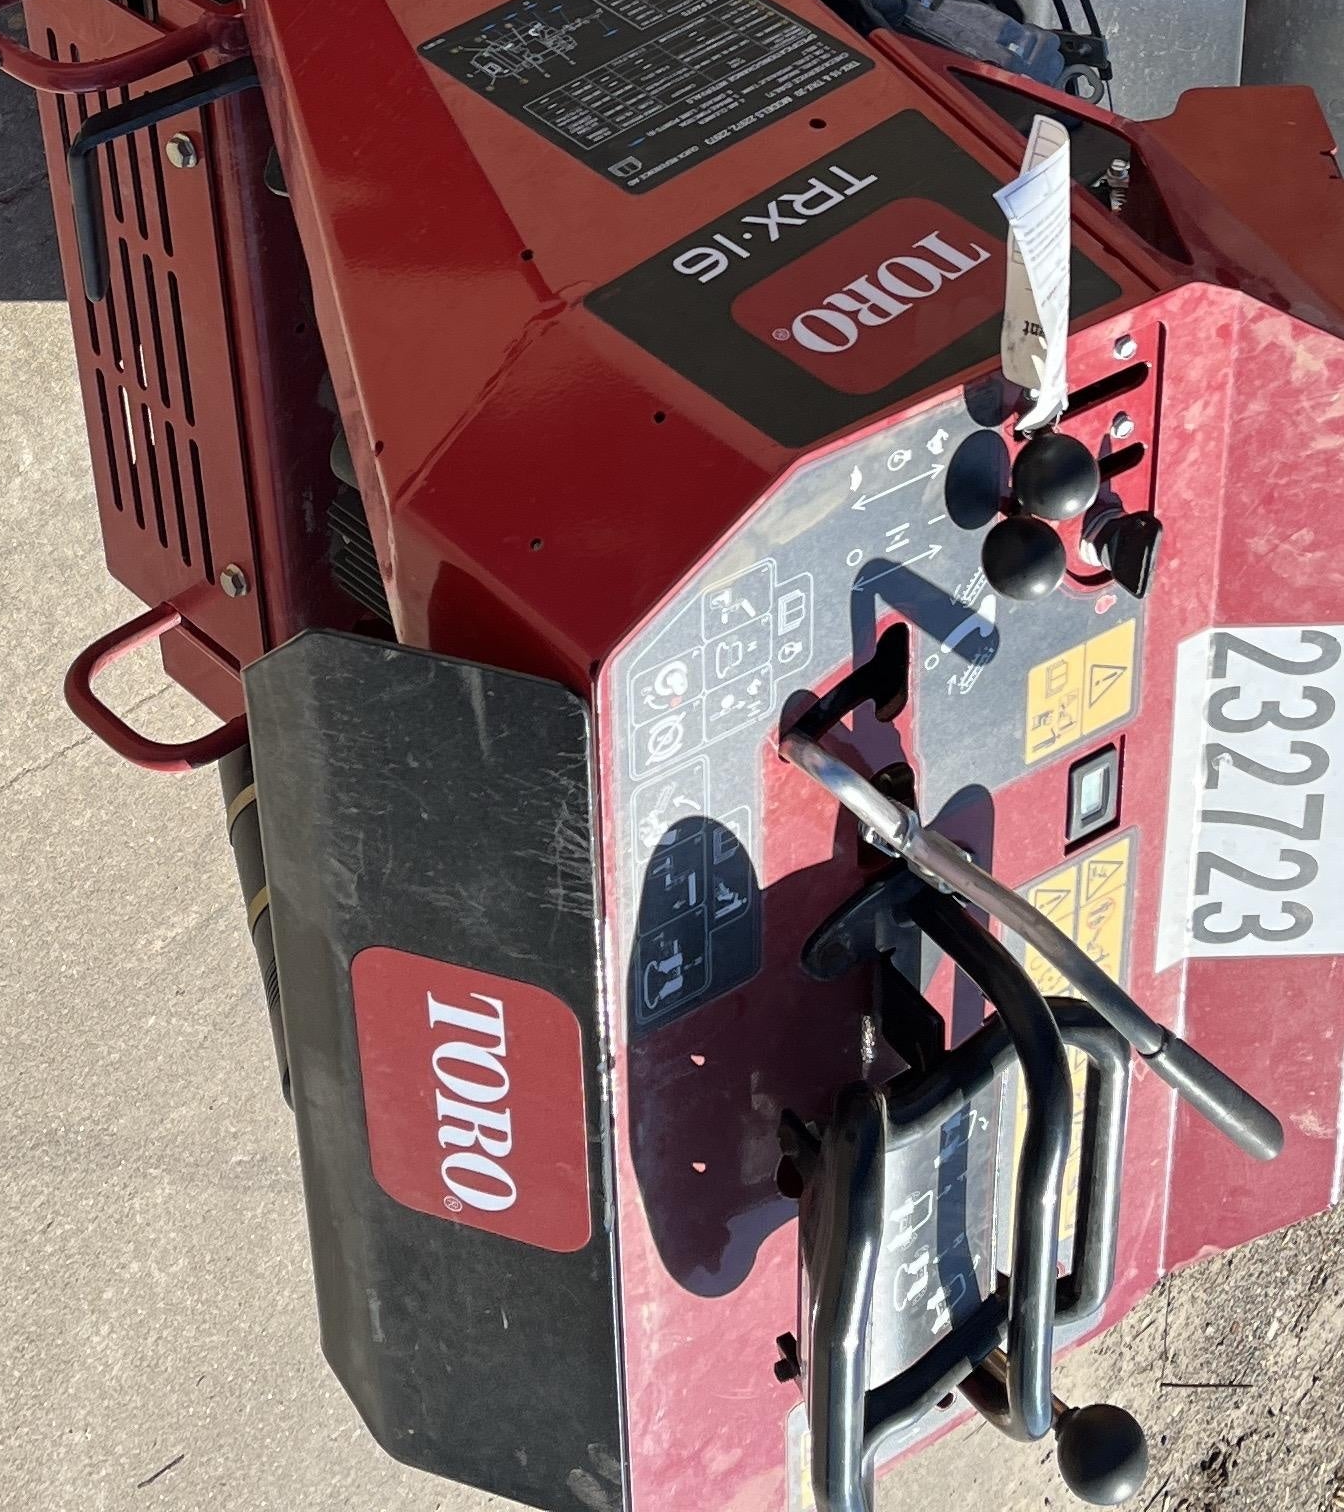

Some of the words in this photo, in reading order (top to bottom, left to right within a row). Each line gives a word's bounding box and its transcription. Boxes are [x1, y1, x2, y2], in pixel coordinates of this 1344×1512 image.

[790, 228, 992, 355] TORO
[1192, 628, 1343, 948] 232723
[425, 989, 517, 1212] TORO
